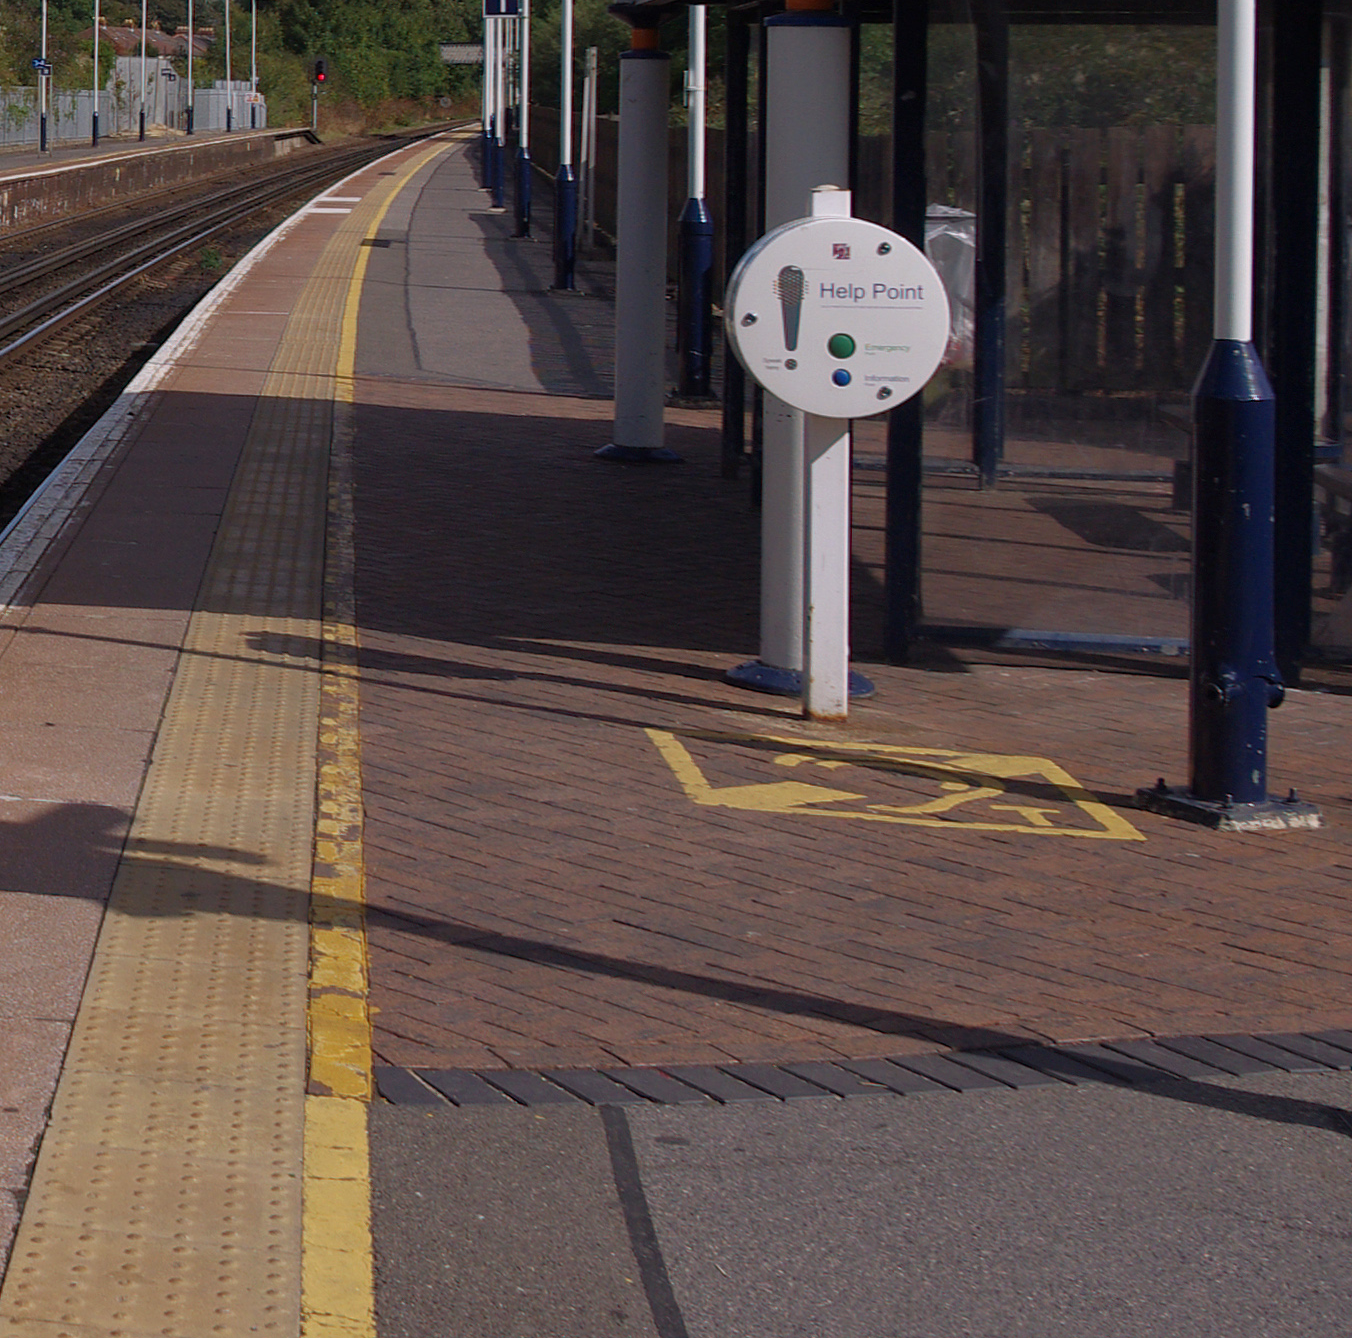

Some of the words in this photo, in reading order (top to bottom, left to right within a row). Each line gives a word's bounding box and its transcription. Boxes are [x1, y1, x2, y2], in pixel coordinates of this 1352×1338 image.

[819, 282, 865, 302] Help
[872, 282, 925, 301] Point
[865, 343, 911, 353] Emergency
